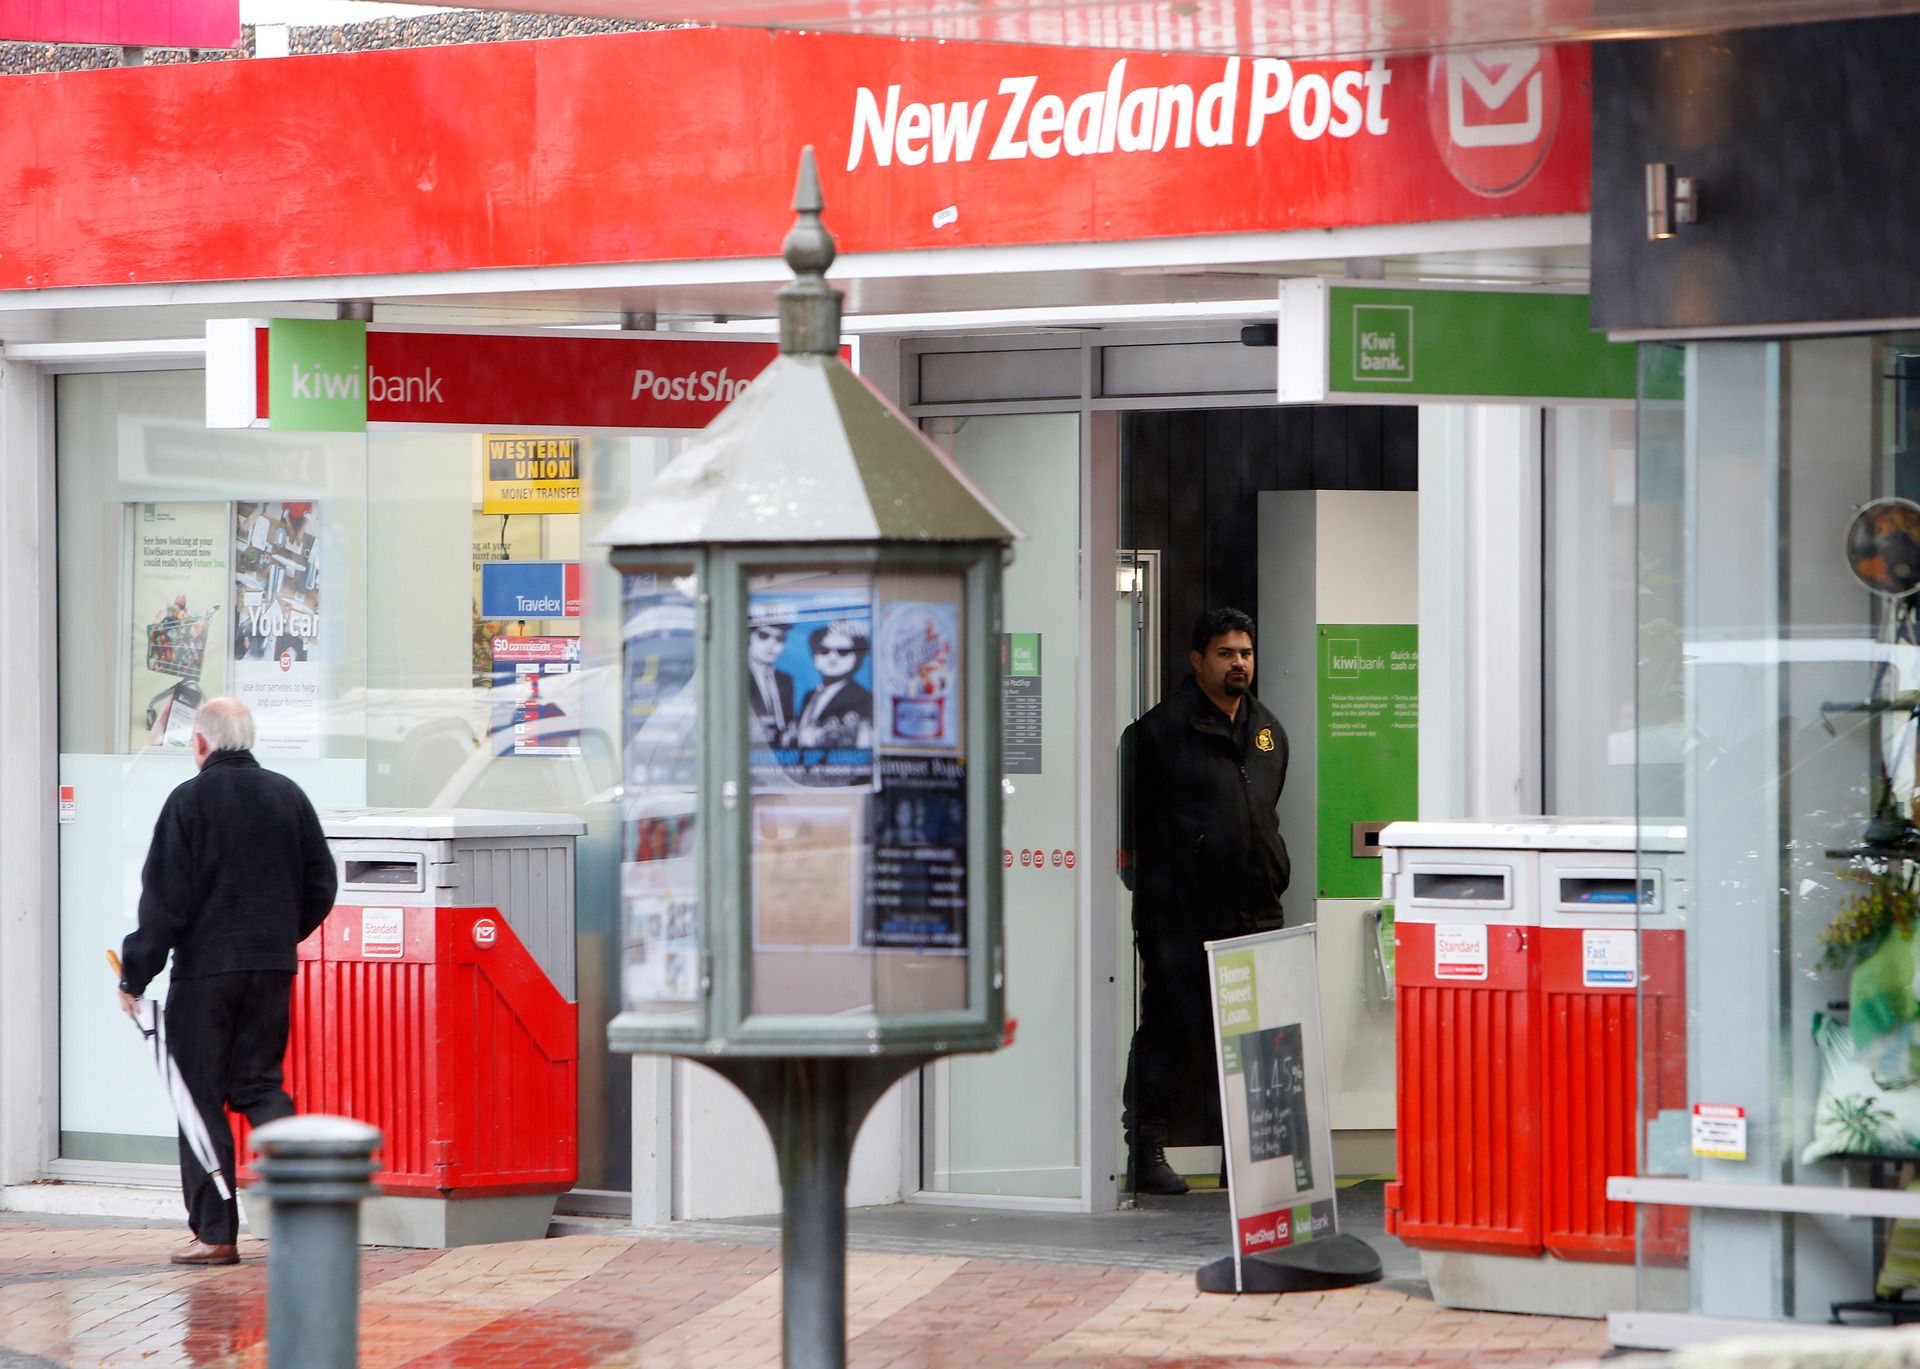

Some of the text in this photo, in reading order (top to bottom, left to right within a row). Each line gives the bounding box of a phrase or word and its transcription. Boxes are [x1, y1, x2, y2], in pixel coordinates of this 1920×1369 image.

[846, 56, 1392, 172] New Zealand Post
[1361, 332, 1396, 350] Kiwi
[1361, 352, 1405, 371] bank.
[632, 367, 753, 402] PostSho
[490, 440, 572, 459] WESTERN
[515, 460, 572, 479] UNION
[501, 488, 534, 500] MONEY
[144, 536, 213, 548] See how looking at your
[175, 549, 198, 557] account
[144, 559, 161, 568] could
[162, 559, 178, 569] really
[179, 559, 193, 570] help
[516, 595, 561, 612] Travelex
[248, 606, 284, 638] You
[494, 639, 551, 653] $0 commission
[1391, 651, 1410, 660] Quick
[1391, 662, 1407, 671] cash
[366, 923, 397, 935] Standard
[1439, 940, 1480, 953] Standard
[1586, 946, 1606, 959] Fast
[1219, 965, 1251, 985] Home
[1220, 984, 1252, 1006] Sweet
[1221, 1008, 1252, 1026] Loan.
[1245, 1228, 1276, 1247] PostShop
